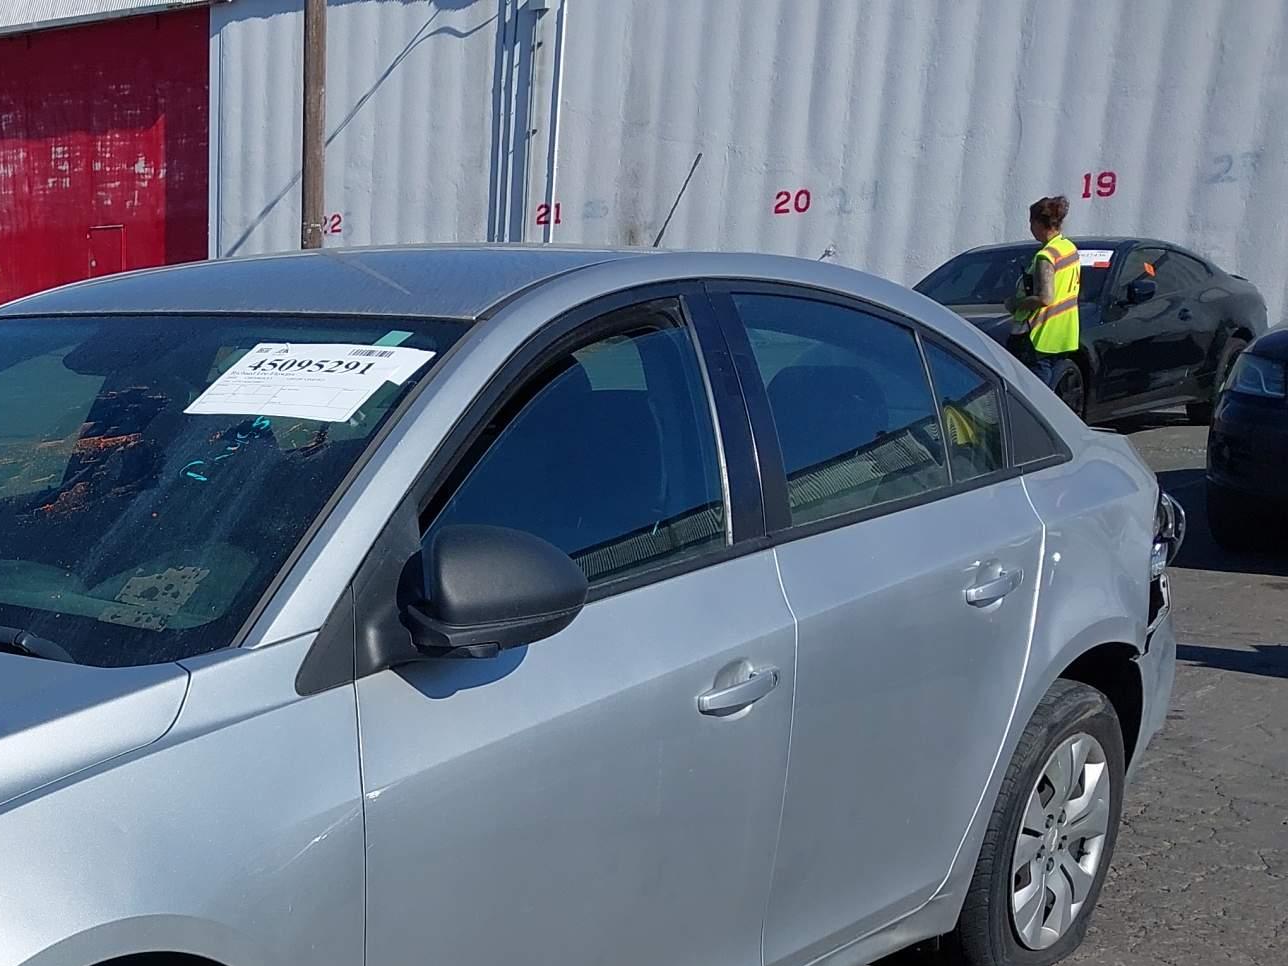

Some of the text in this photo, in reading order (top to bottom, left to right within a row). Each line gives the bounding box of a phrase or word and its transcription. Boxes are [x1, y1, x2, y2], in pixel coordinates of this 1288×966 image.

[1082, 171, 1116, 198] 19
[536, 202, 561, 225] 21
[774, 189, 811, 214] 20
[248, 358, 375, 375] 45095291
